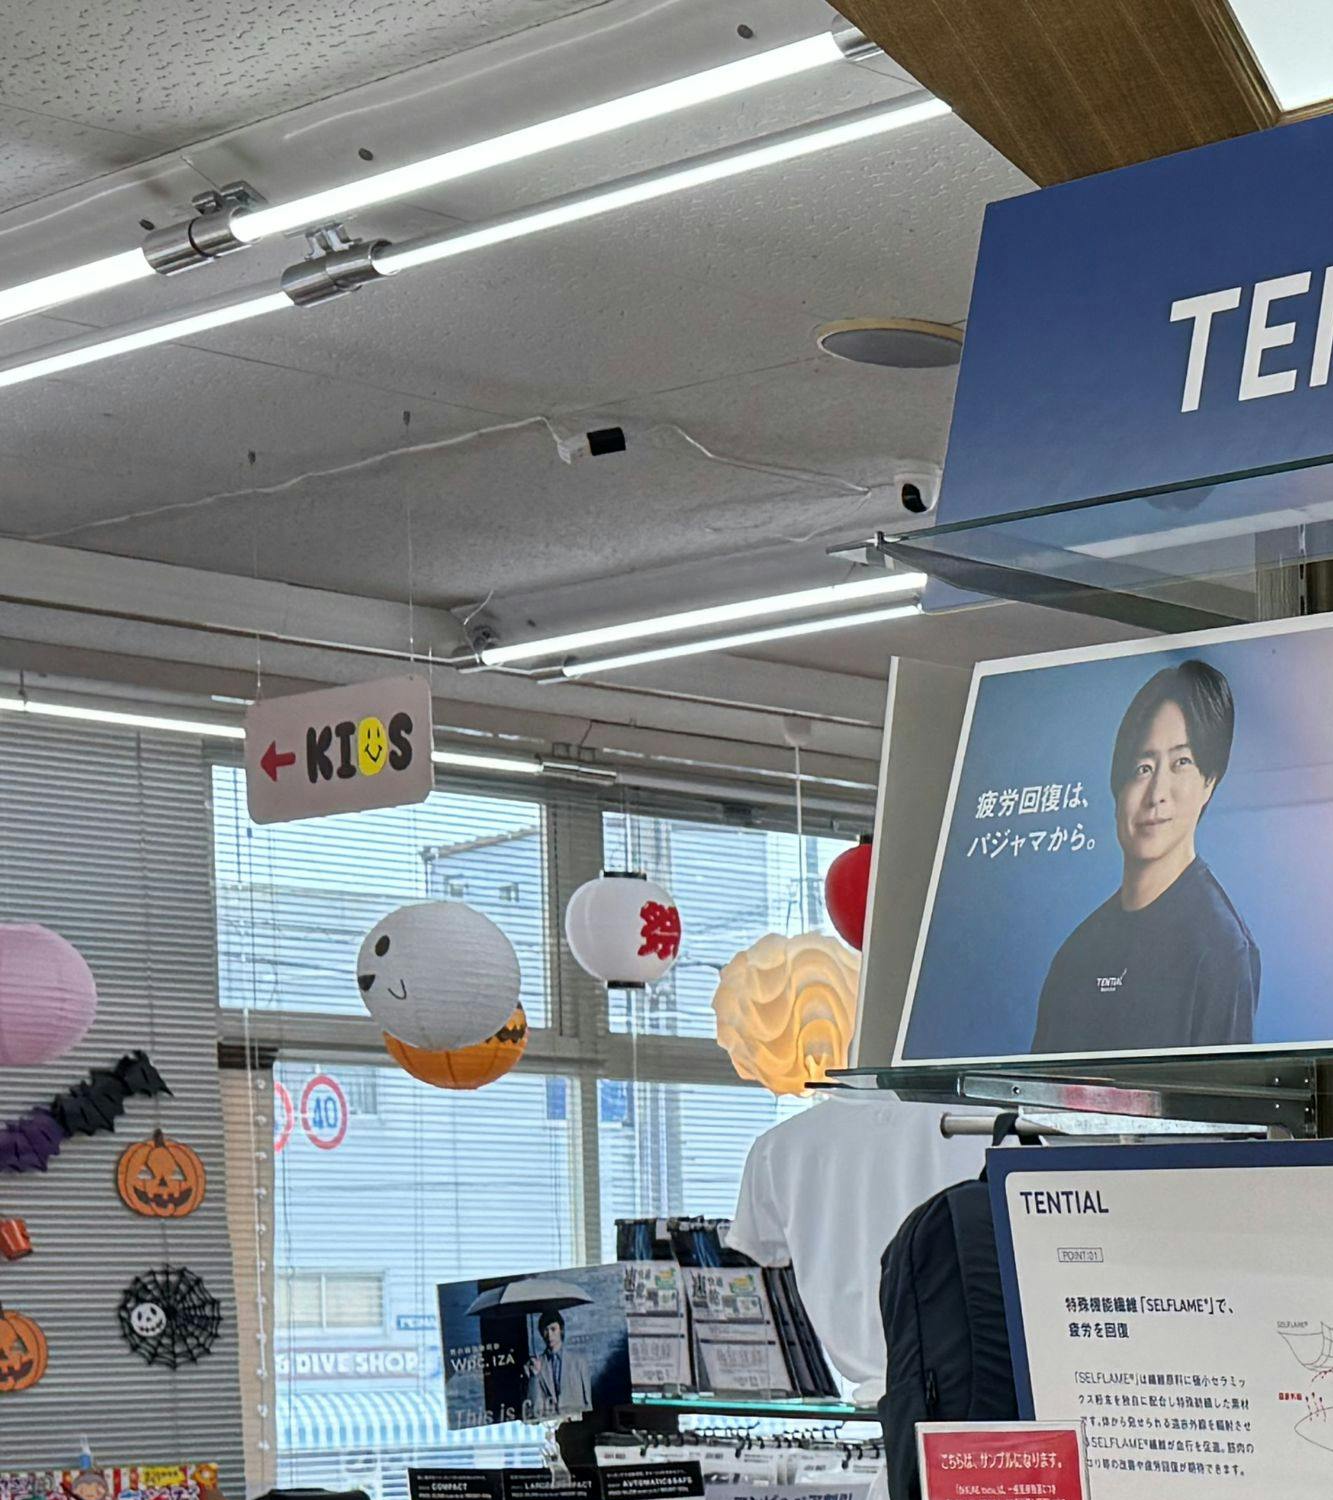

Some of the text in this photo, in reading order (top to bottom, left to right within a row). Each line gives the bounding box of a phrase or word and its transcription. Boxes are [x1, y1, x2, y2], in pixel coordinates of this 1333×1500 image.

[974, 783, 1091, 820] 疲労回復は、
[966, 822, 1097, 859] パジャマから。
[1020, 1189, 1110, 1215] TENTIAL
[1068, 1322, 1130, 1339] 疲労を回復
[298, 1351, 351, 1374] DIVE
[450, 1356, 491, 1373] Wpc.
